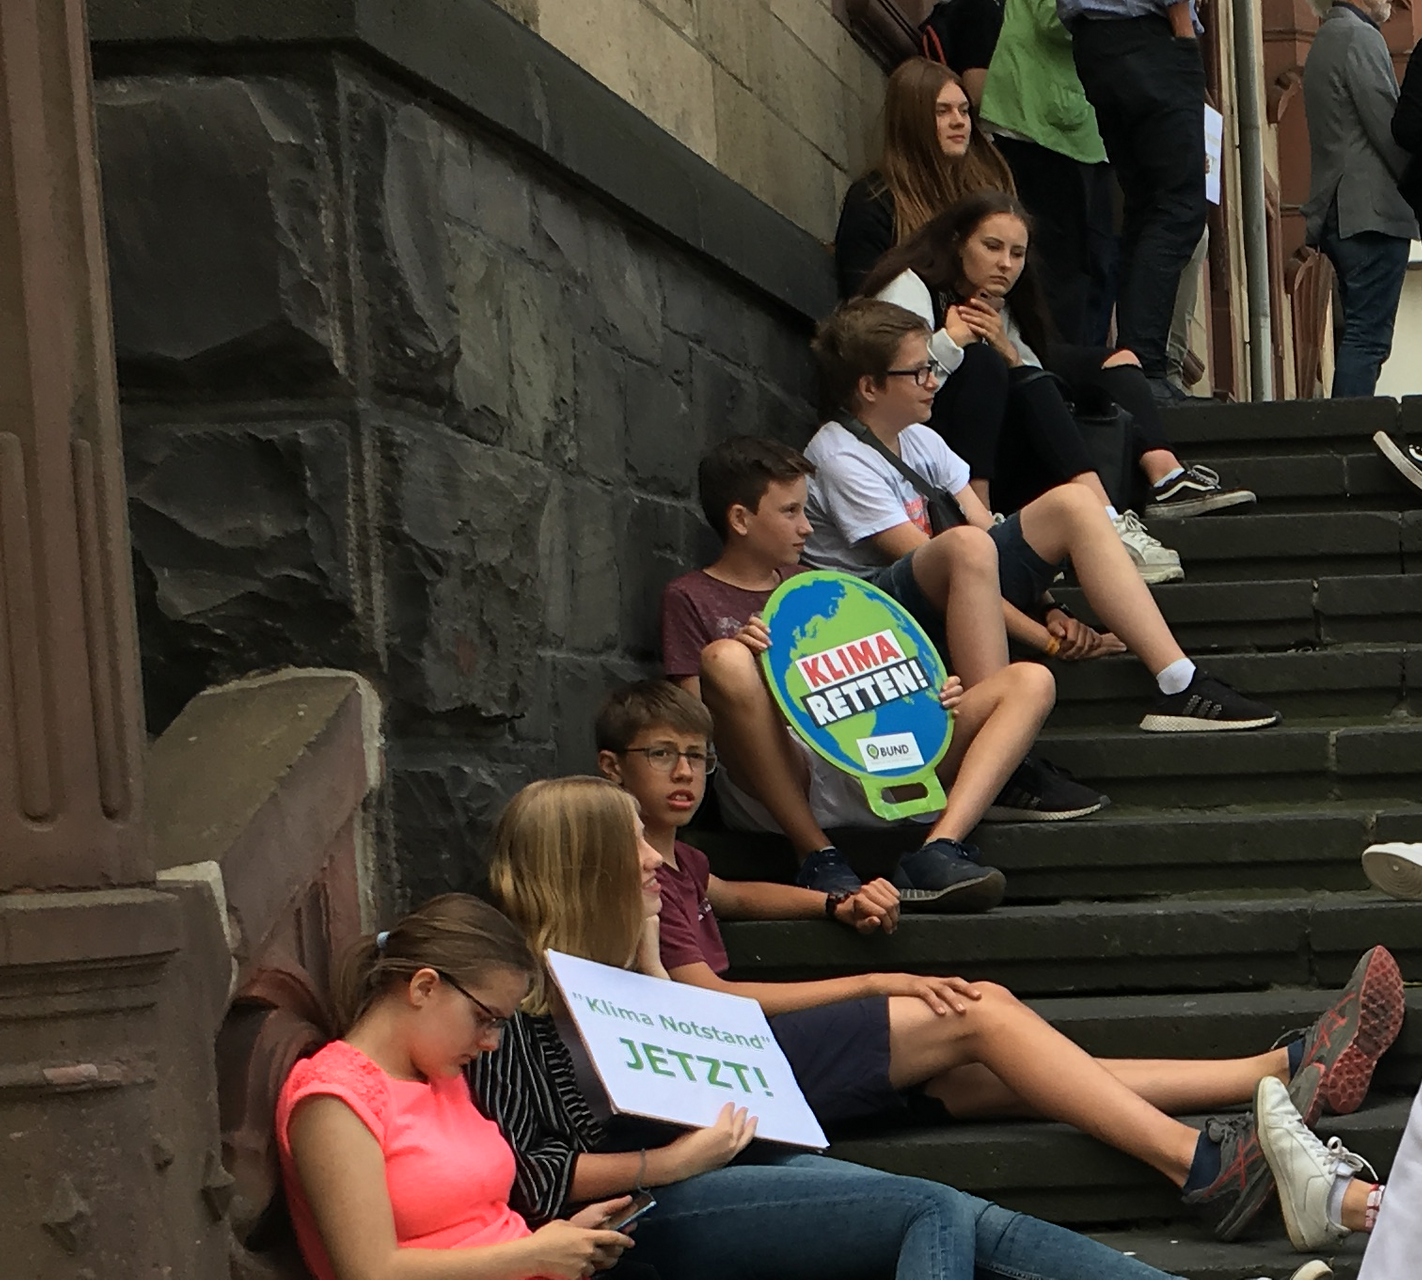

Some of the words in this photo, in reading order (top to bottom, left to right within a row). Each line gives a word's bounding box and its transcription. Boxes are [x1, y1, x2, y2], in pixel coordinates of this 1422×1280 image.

[801, 633, 902, 688] KLIMA
[806, 659, 929, 726] RETTEN!
[880, 744, 909, 757] BUND
[572, 991, 654, 1026] "Klima
[658, 1014, 770, 1050] Notstand"
[618, 1037, 775, 1098] JETZT!
